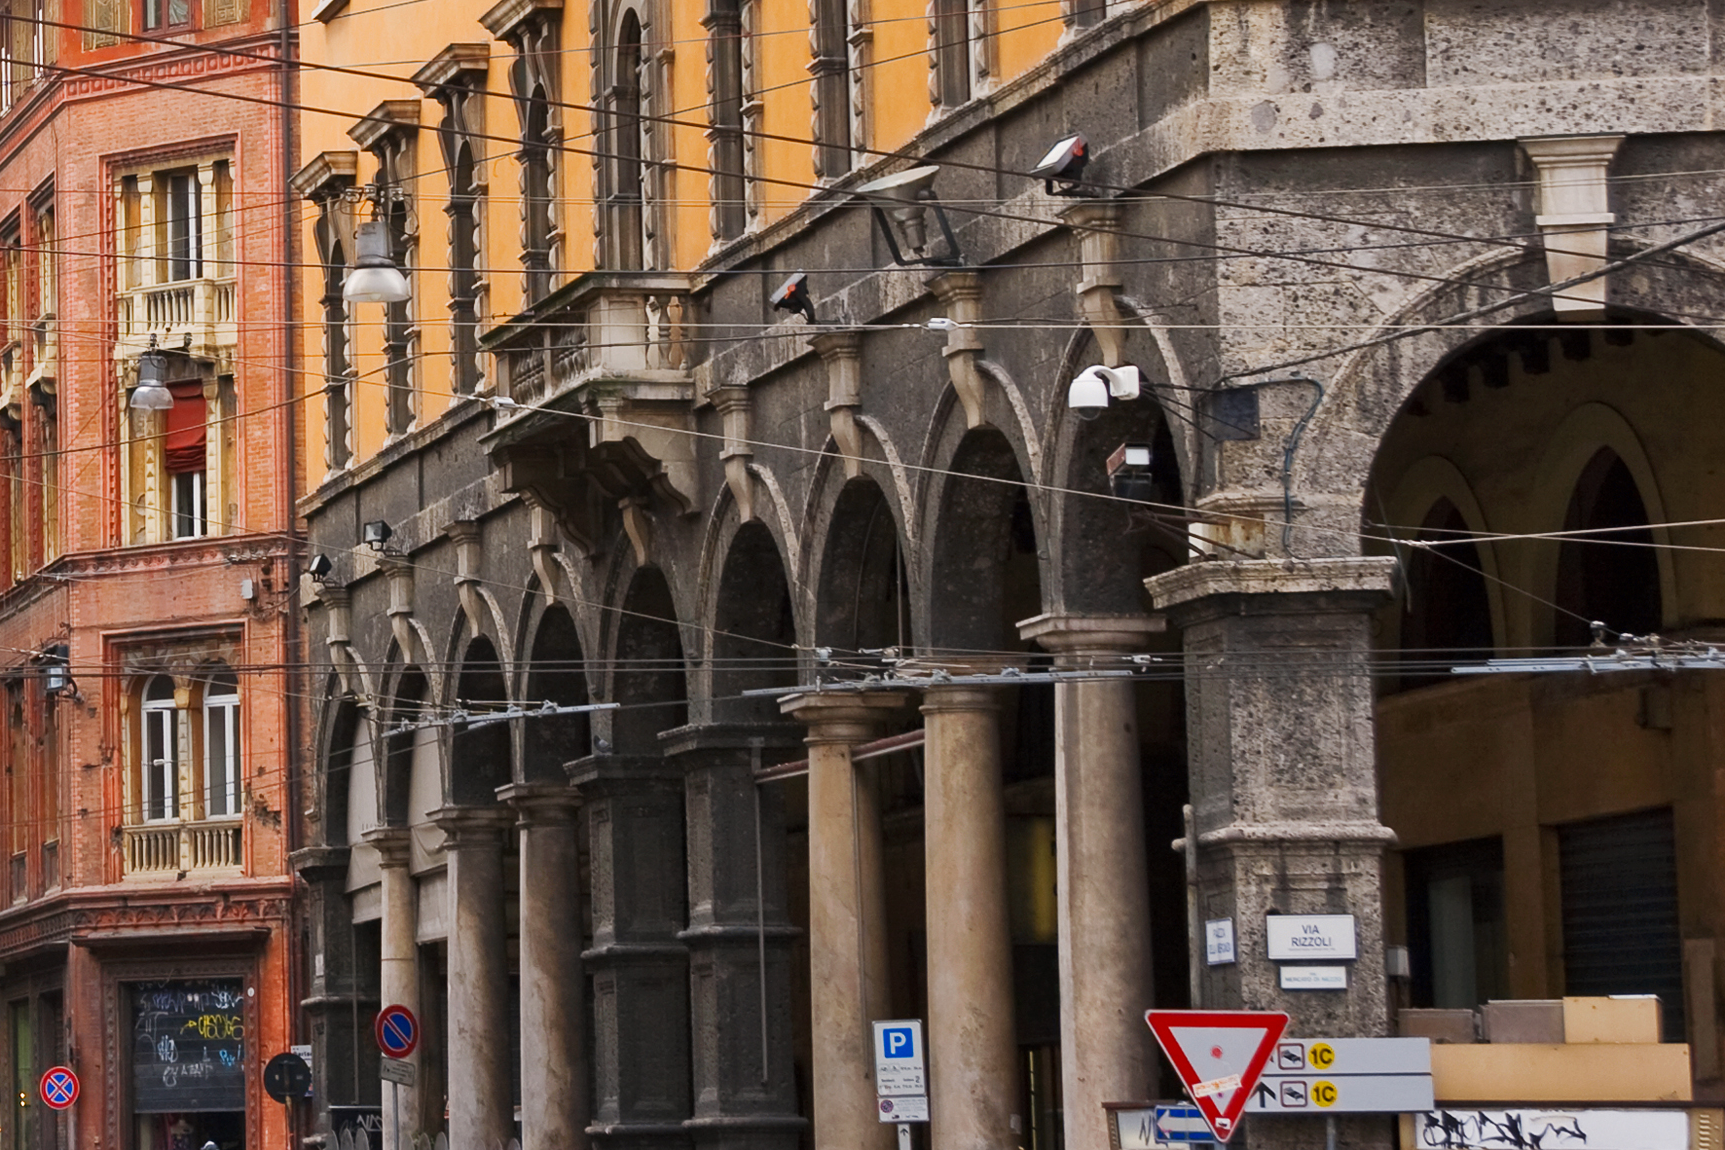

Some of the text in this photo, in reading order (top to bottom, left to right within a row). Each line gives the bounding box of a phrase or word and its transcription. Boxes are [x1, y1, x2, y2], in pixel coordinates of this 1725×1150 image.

[1301, 925, 1320, 934] VIA
[1291, 936, 1332, 947] RIZZOLI
[889, 1032, 907, 1055] P
[1311, 1048, 1332, 1064] 1C
[1314, 1086, 1335, 1102] 1C
